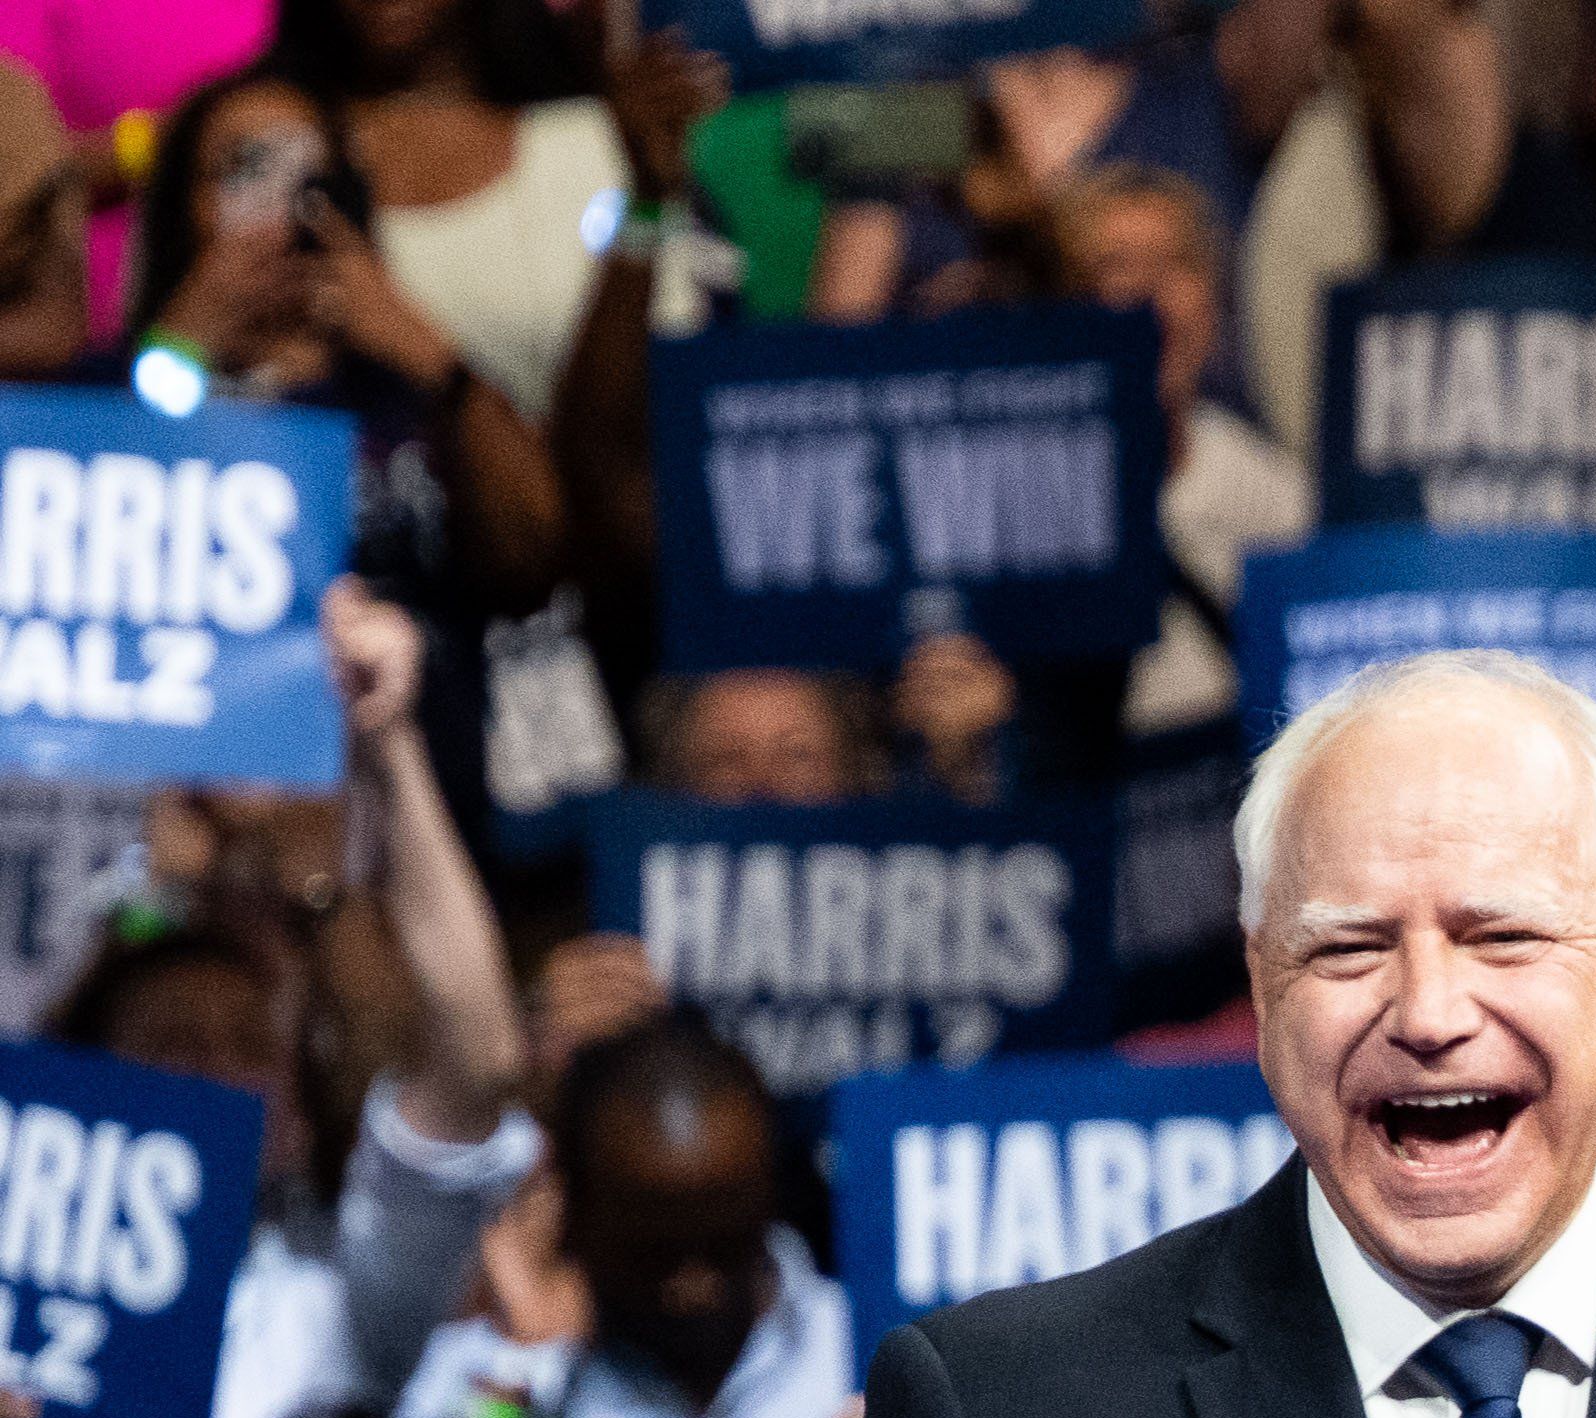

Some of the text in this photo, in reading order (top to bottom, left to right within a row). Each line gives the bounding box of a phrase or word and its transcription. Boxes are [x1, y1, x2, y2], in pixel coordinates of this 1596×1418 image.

[705, 416, 1120, 592] WE WIN
[0, 618, 218, 726] ALZ
[641, 842, 1074, 1008] HARRIS
